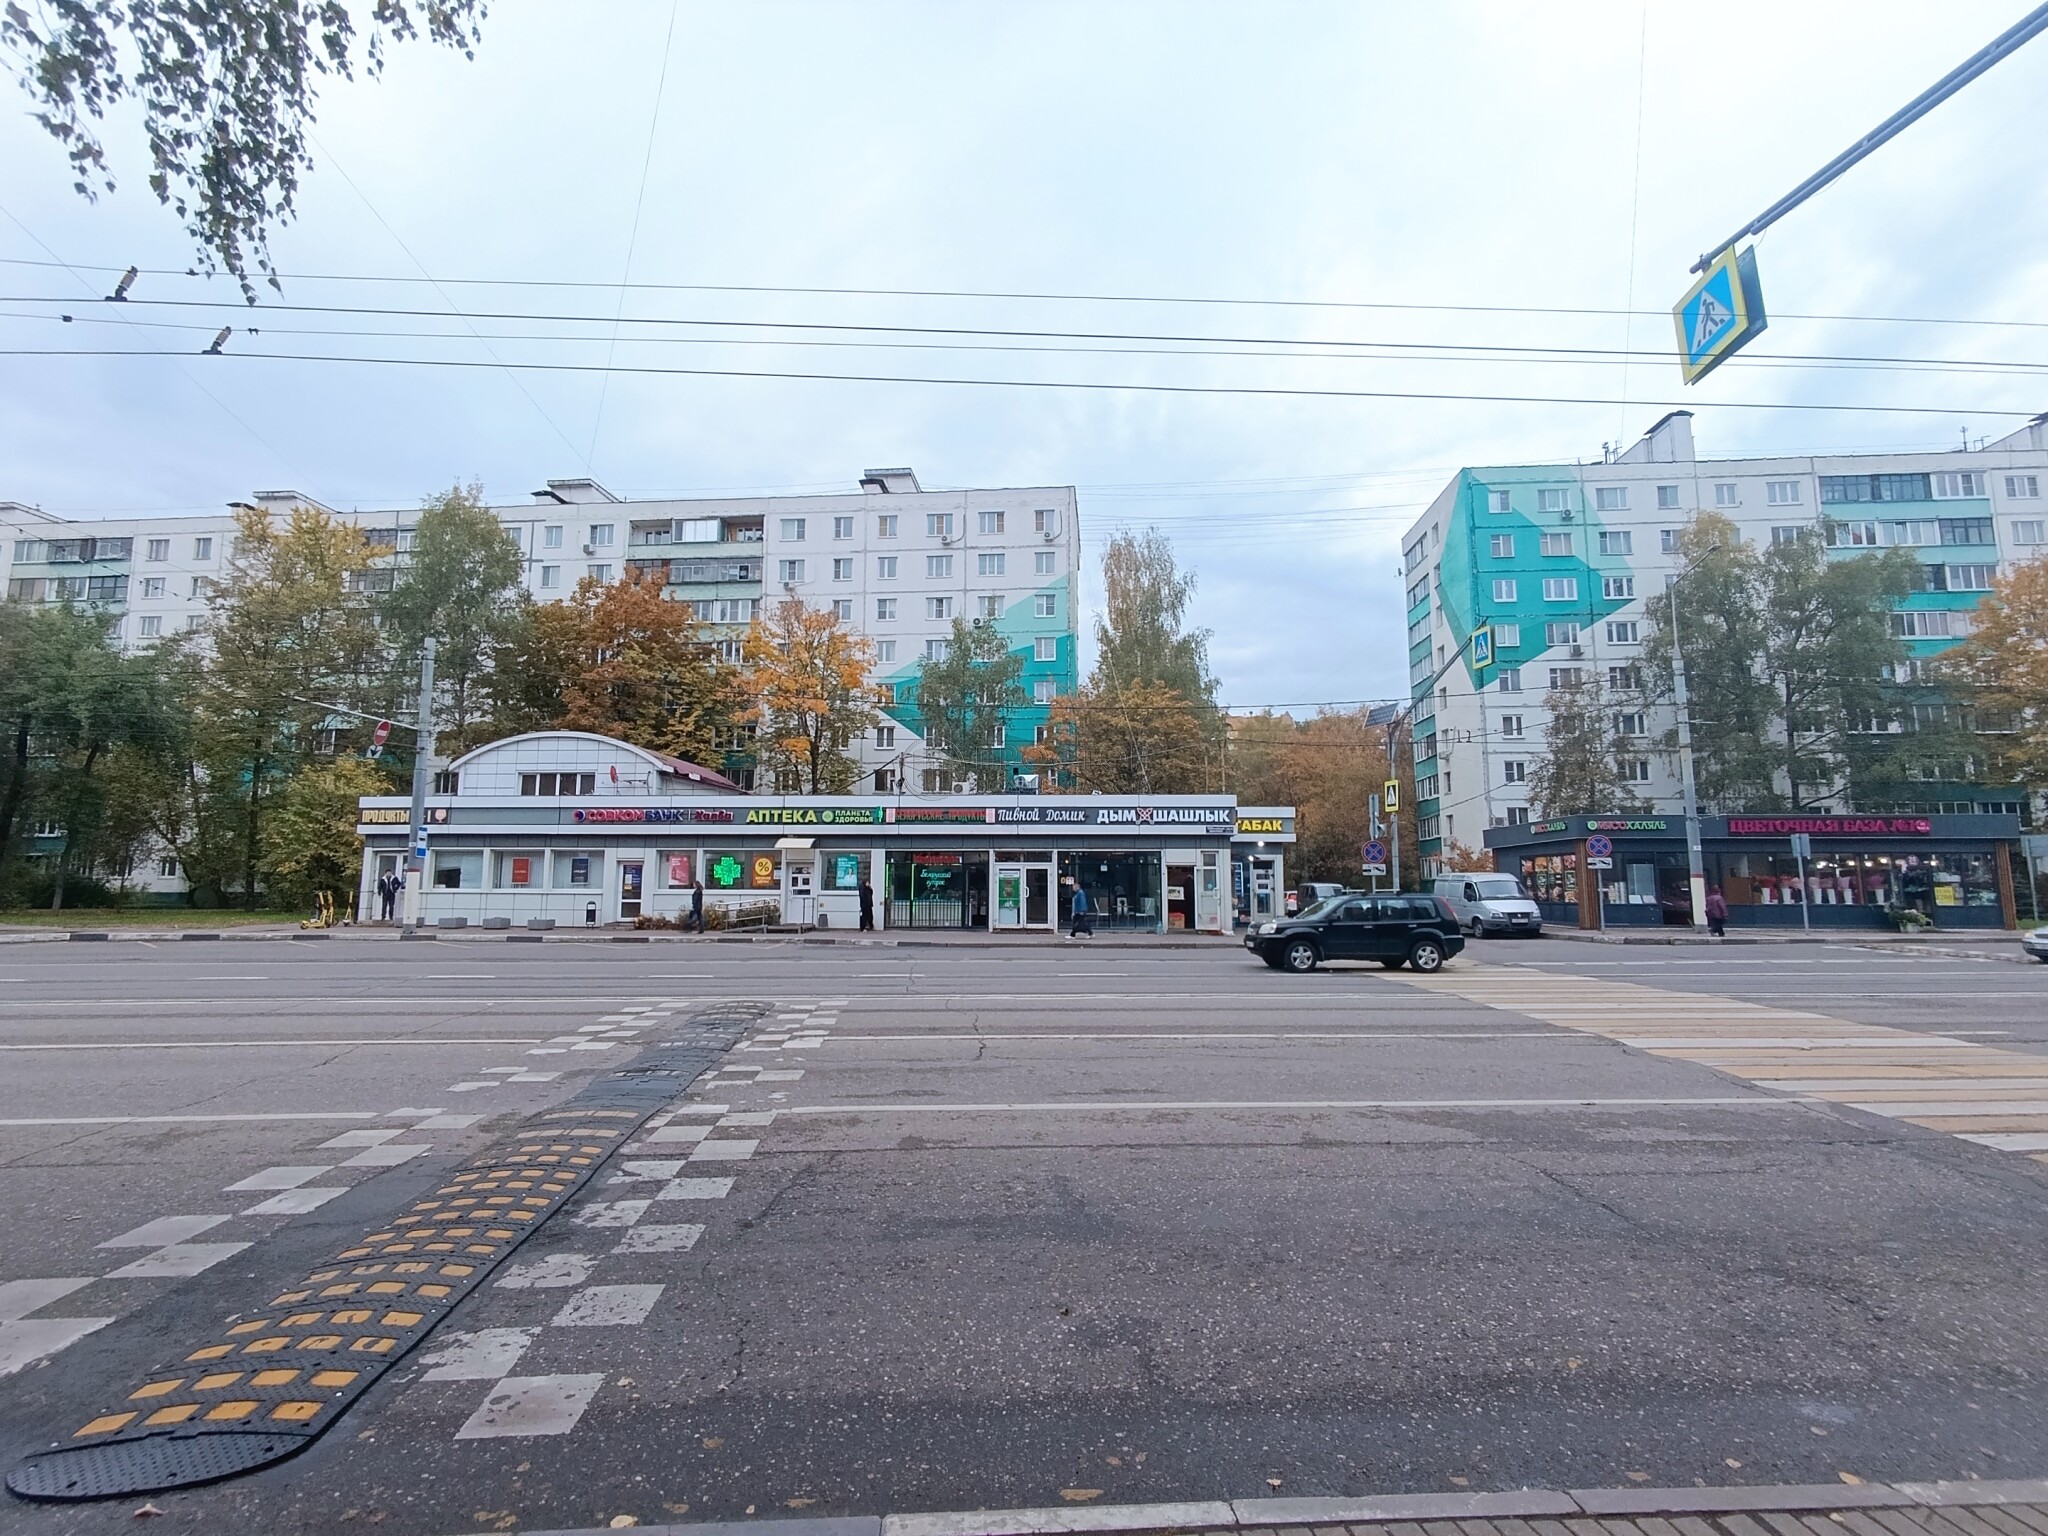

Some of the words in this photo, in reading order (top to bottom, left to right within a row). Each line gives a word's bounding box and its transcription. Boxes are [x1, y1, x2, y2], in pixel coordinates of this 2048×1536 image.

[362, 809, 410, 823] ПРОДУКТЫ
[587, 808, 684, 822] СОВКОМБАНК
[746, 809, 818, 823] АПТЕКА
[997, 807, 1040, 822] Пивной
[1046, 808, 1086, 822] Домик
[1096, 809, 1137, 824] ДЫМ
[1152, 809, 1230, 823] ШАШЛЫК
[1730, 819, 1839, 834] ЦВЕТОЧНАЯ
[1843, 820, 1887, 833] БАЗА
